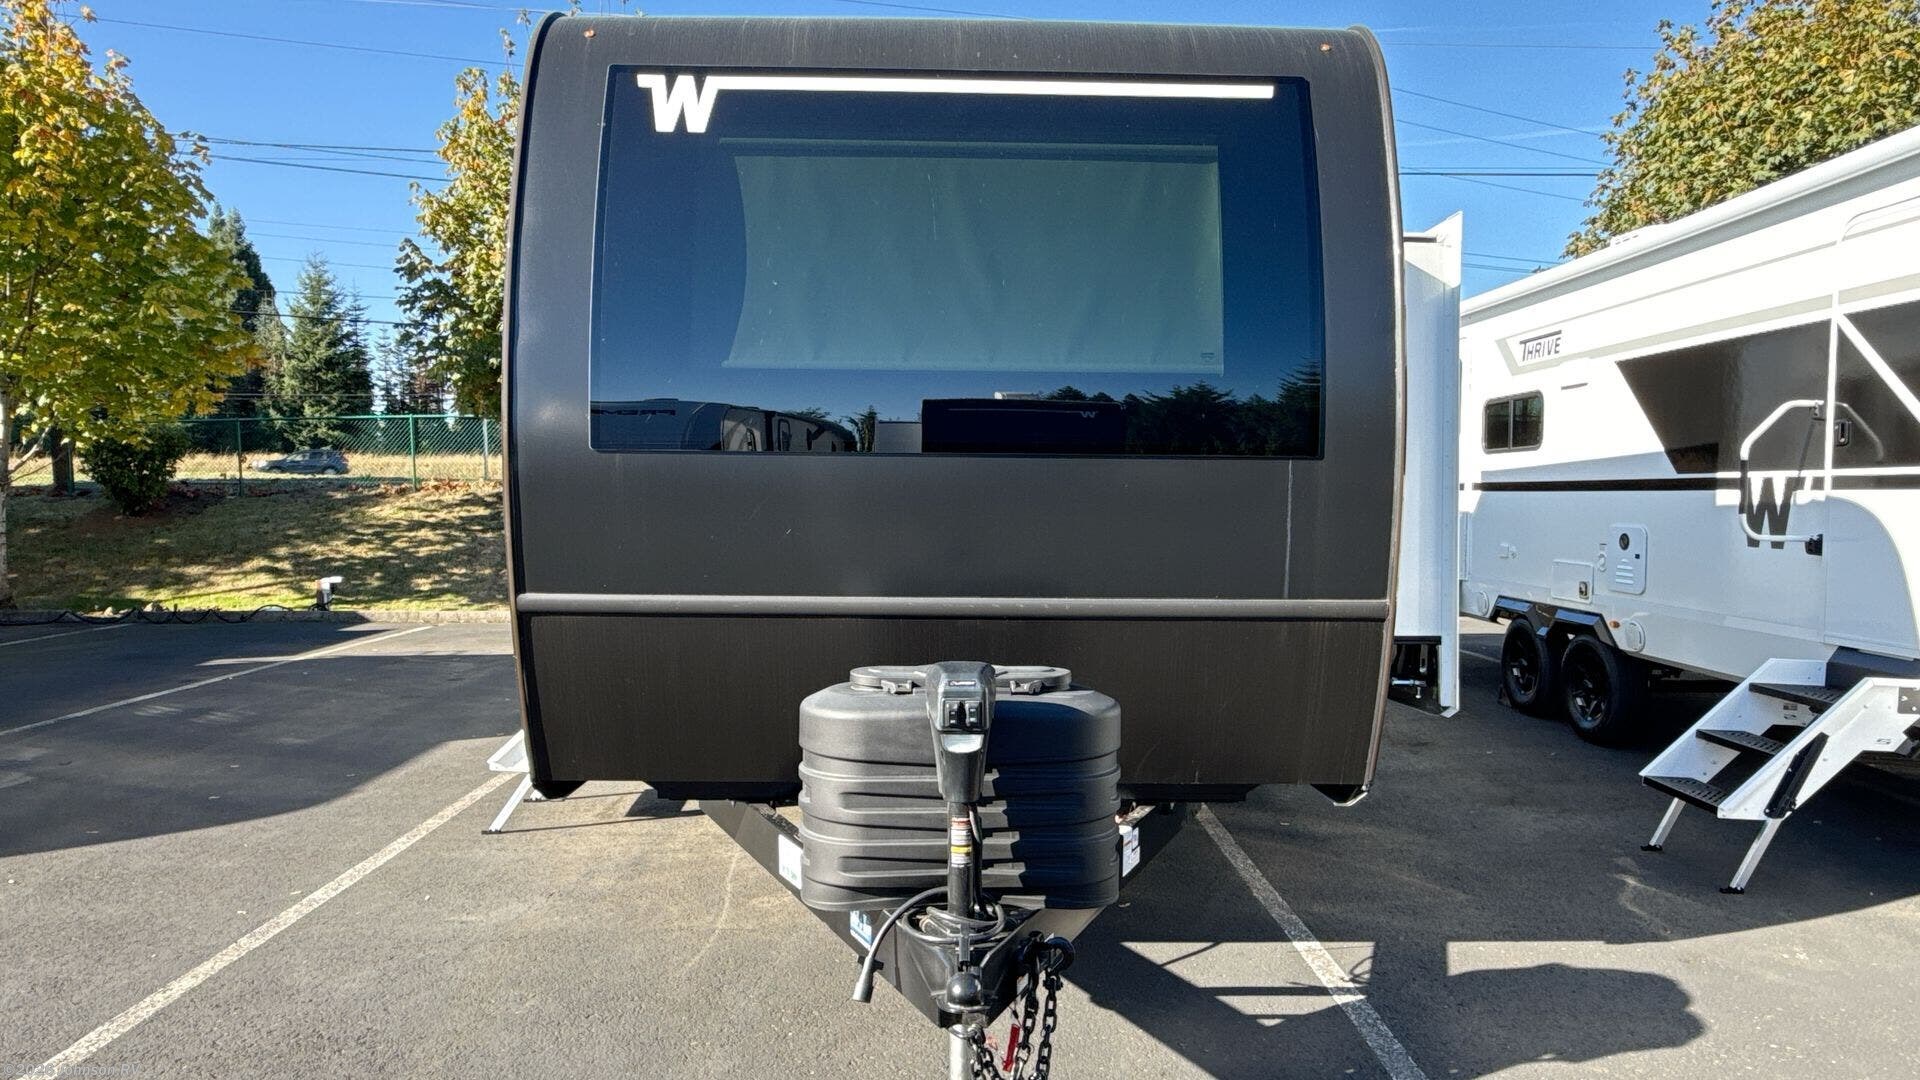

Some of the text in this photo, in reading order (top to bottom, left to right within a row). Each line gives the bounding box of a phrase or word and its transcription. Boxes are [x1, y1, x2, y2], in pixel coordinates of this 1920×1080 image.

[637, 73, 719, 133] W
[1519, 329, 1562, 362] THRIVE
[1742, 477, 1794, 549] W
